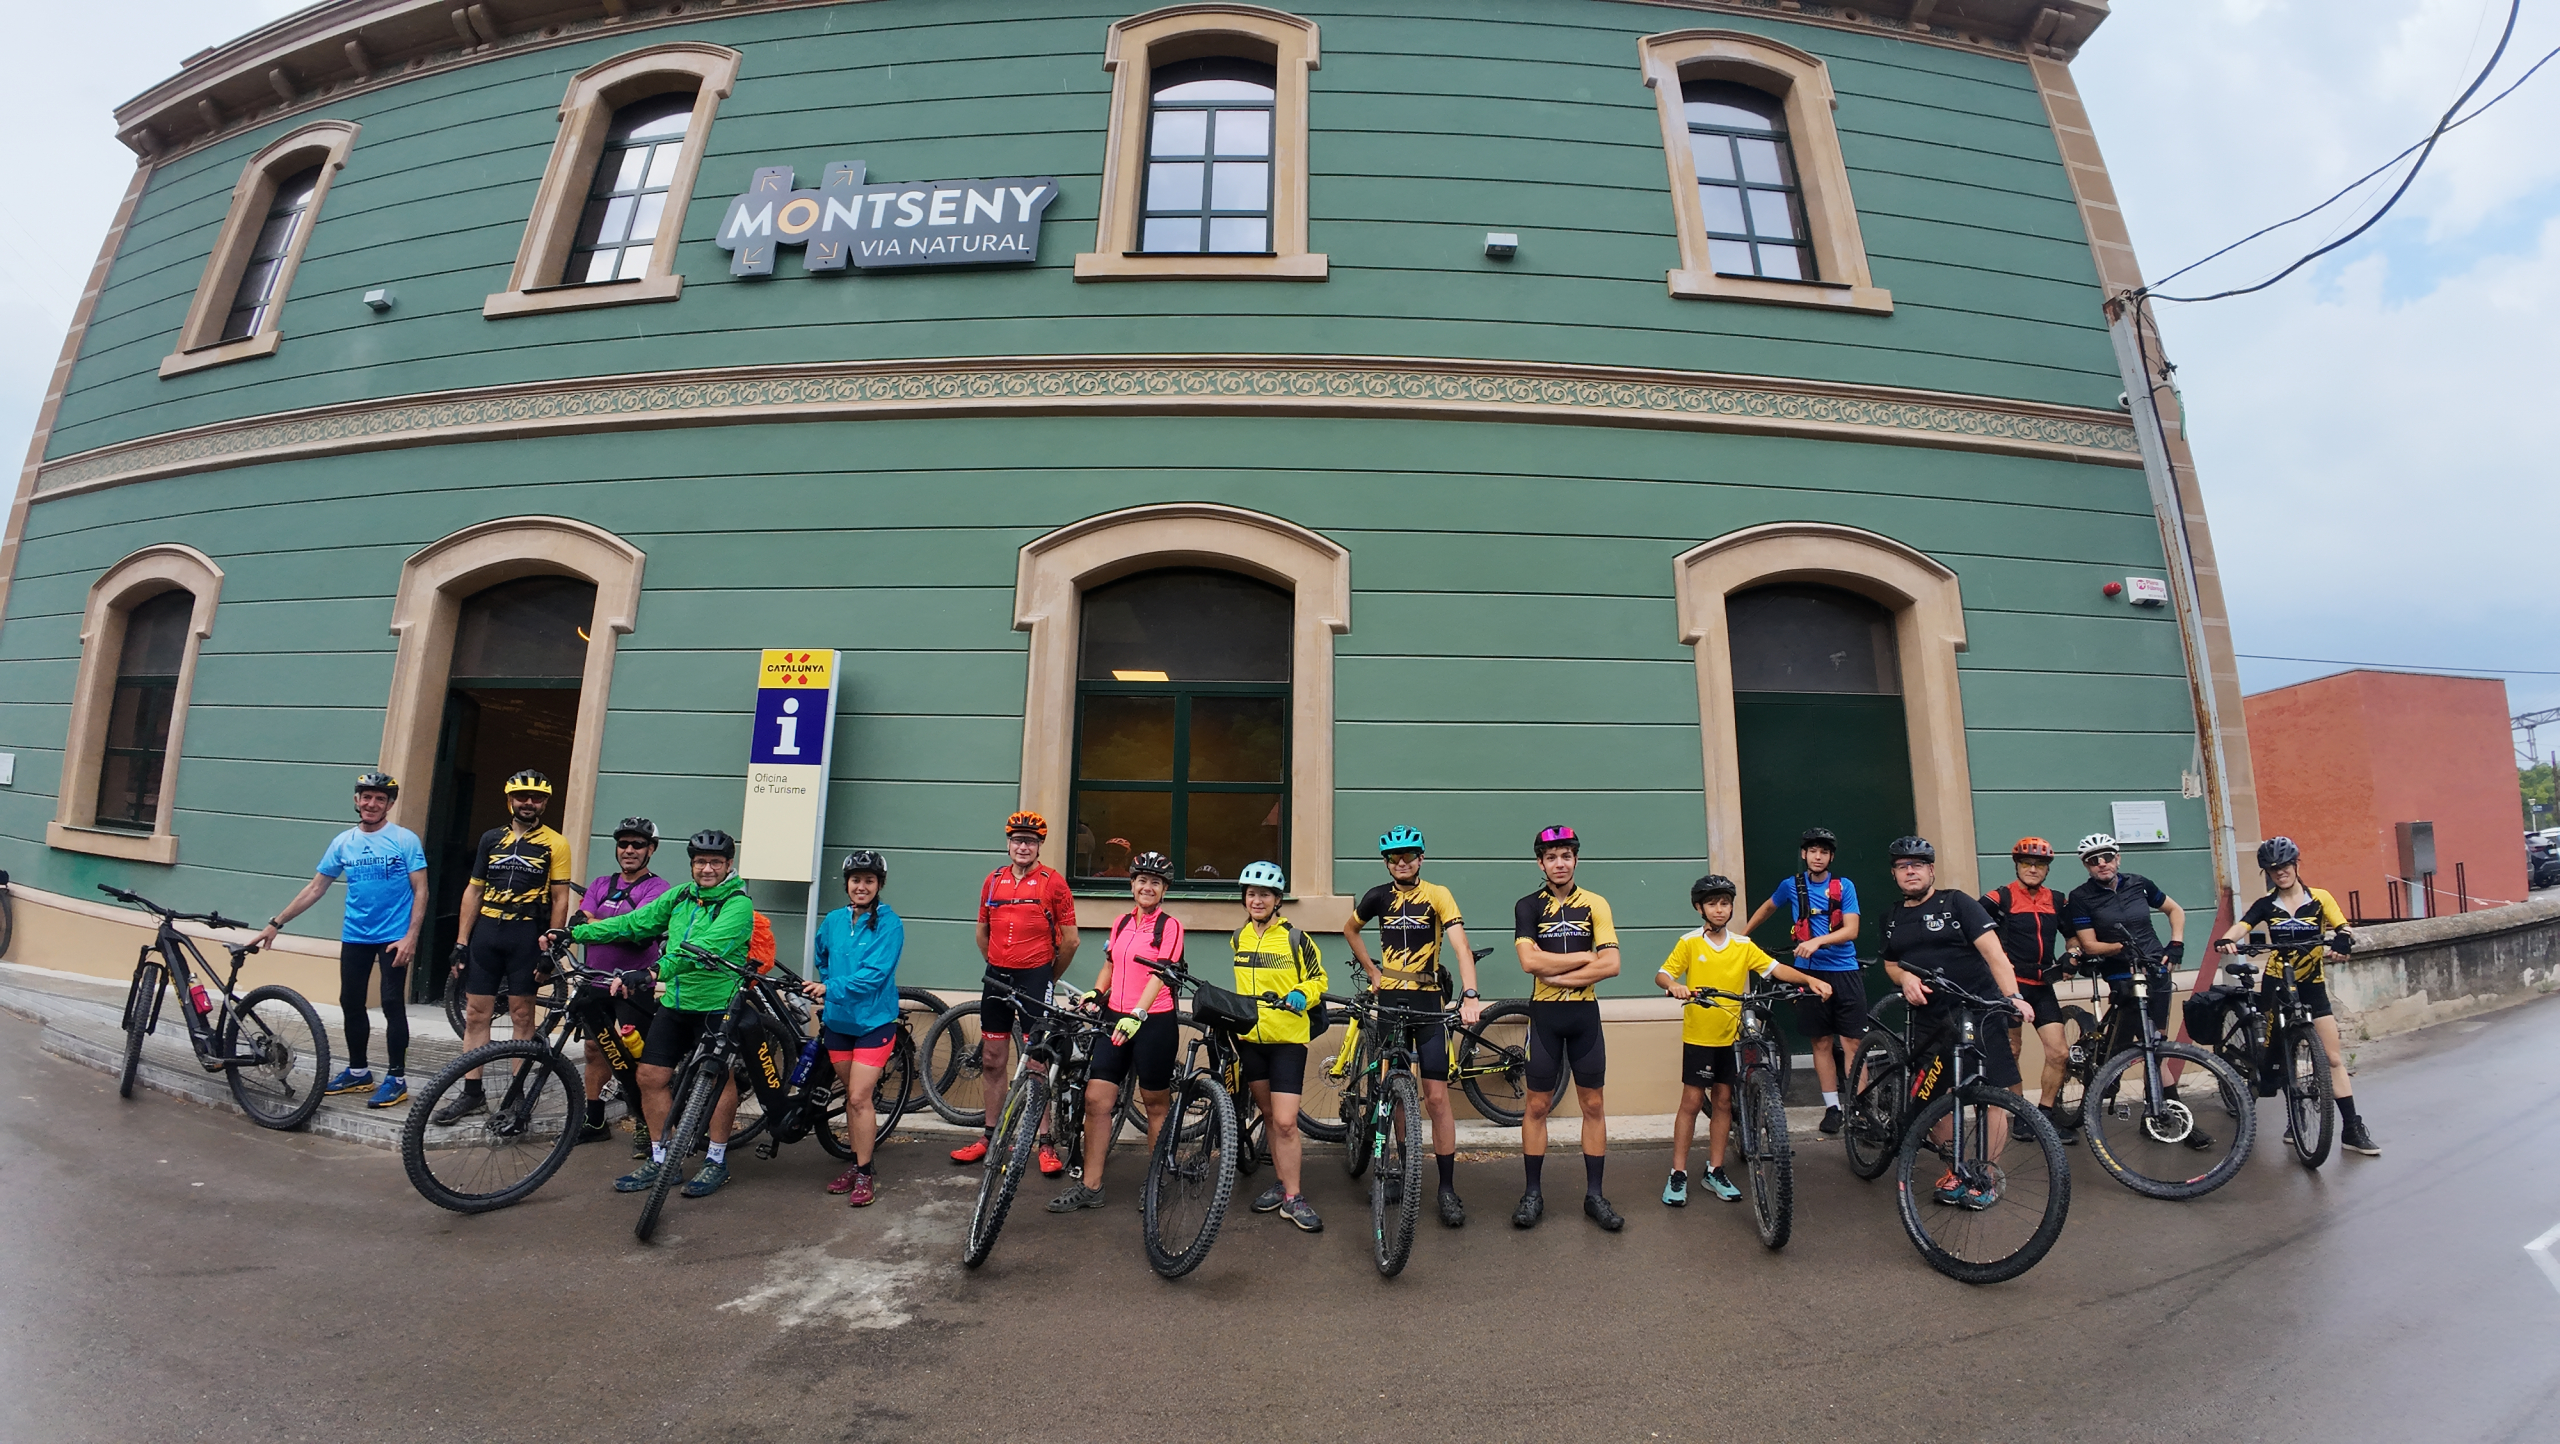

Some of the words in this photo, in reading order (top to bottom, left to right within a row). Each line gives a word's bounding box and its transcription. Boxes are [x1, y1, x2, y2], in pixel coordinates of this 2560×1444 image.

[727, 186, 1047, 239] MONTSENY
[860, 239, 901, 257] VIA
[909, 233, 1030, 255] NATURAL
[767, 664, 825, 673] CATALUNYA
[755, 772, 788, 783] Oficina
[753, 784, 766, 793] de
[768, 784, 807, 795] Turisme
[1482, 1066, 1511, 1074] SCOTT
